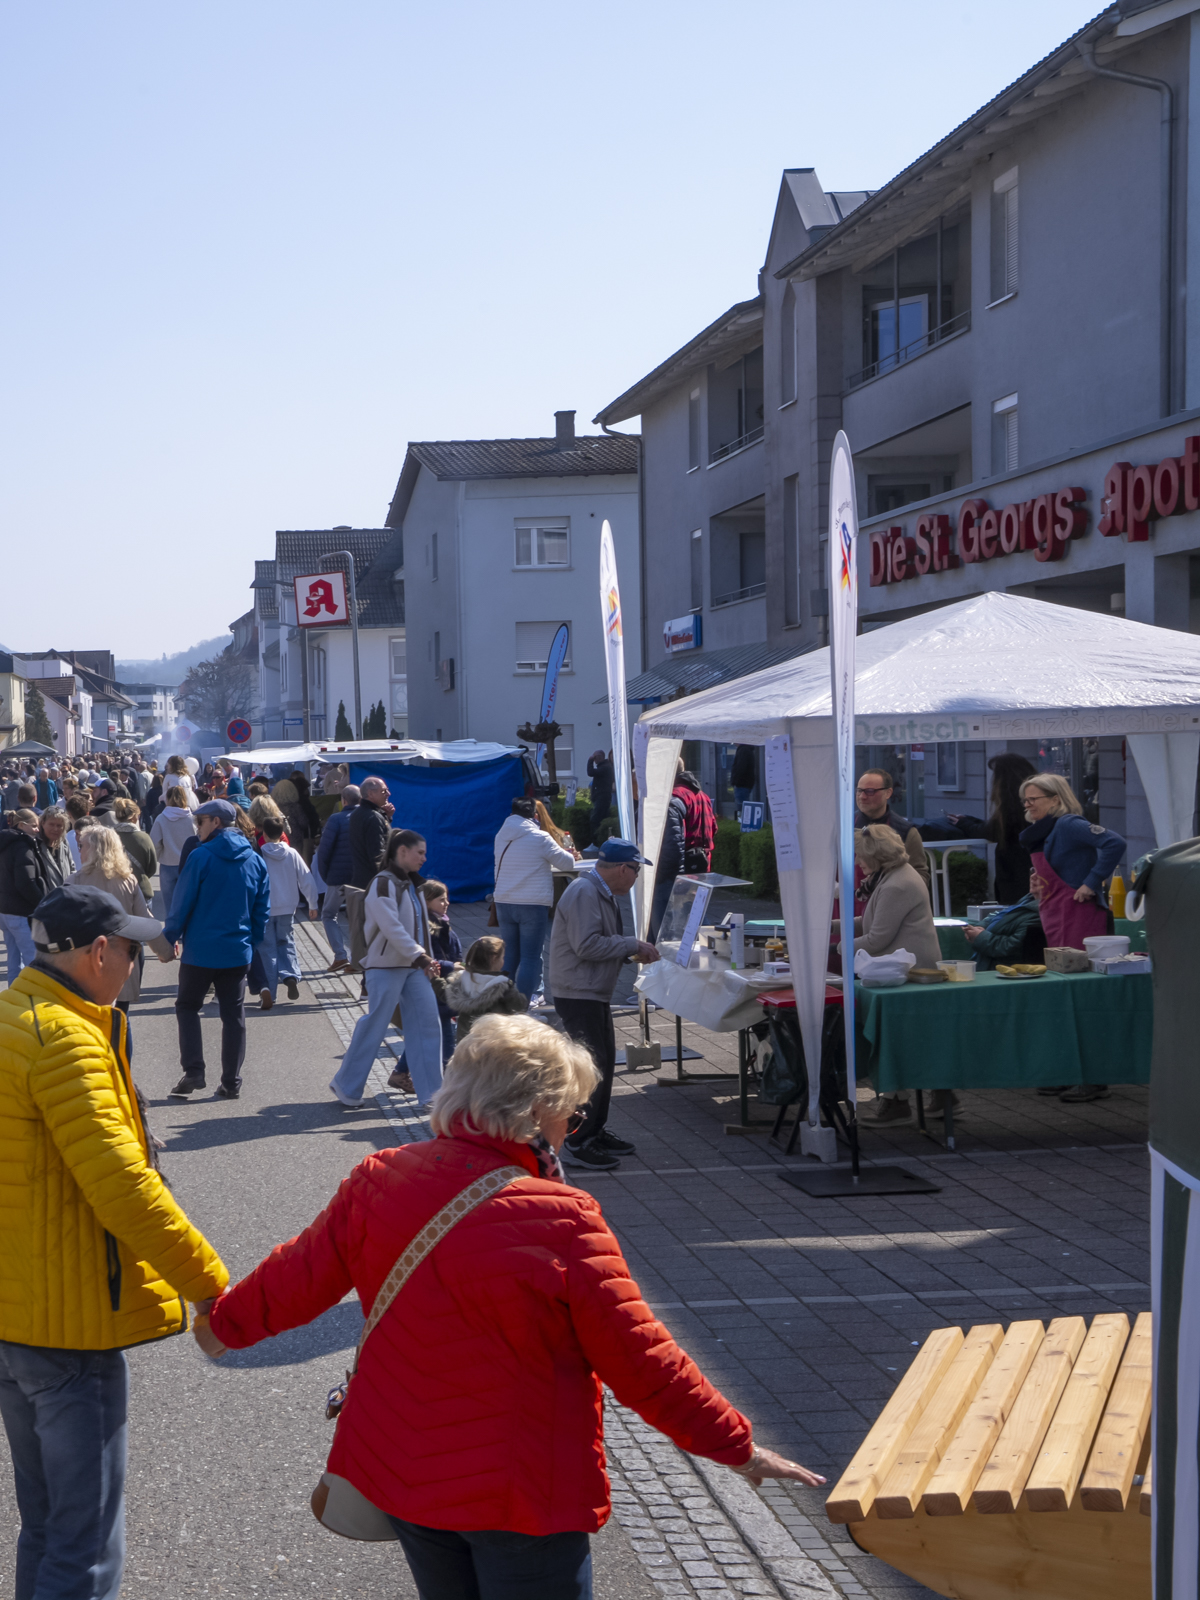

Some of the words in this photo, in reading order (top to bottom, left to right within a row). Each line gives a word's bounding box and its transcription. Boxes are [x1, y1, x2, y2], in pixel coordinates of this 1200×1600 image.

[869, 527, 912, 587] Die
[915, 514, 959, 575] St.
[958, 486, 1088, 562] Georgs
[982, 709, 1190, 738] Französischer
[753, 806, 762, 826] P
